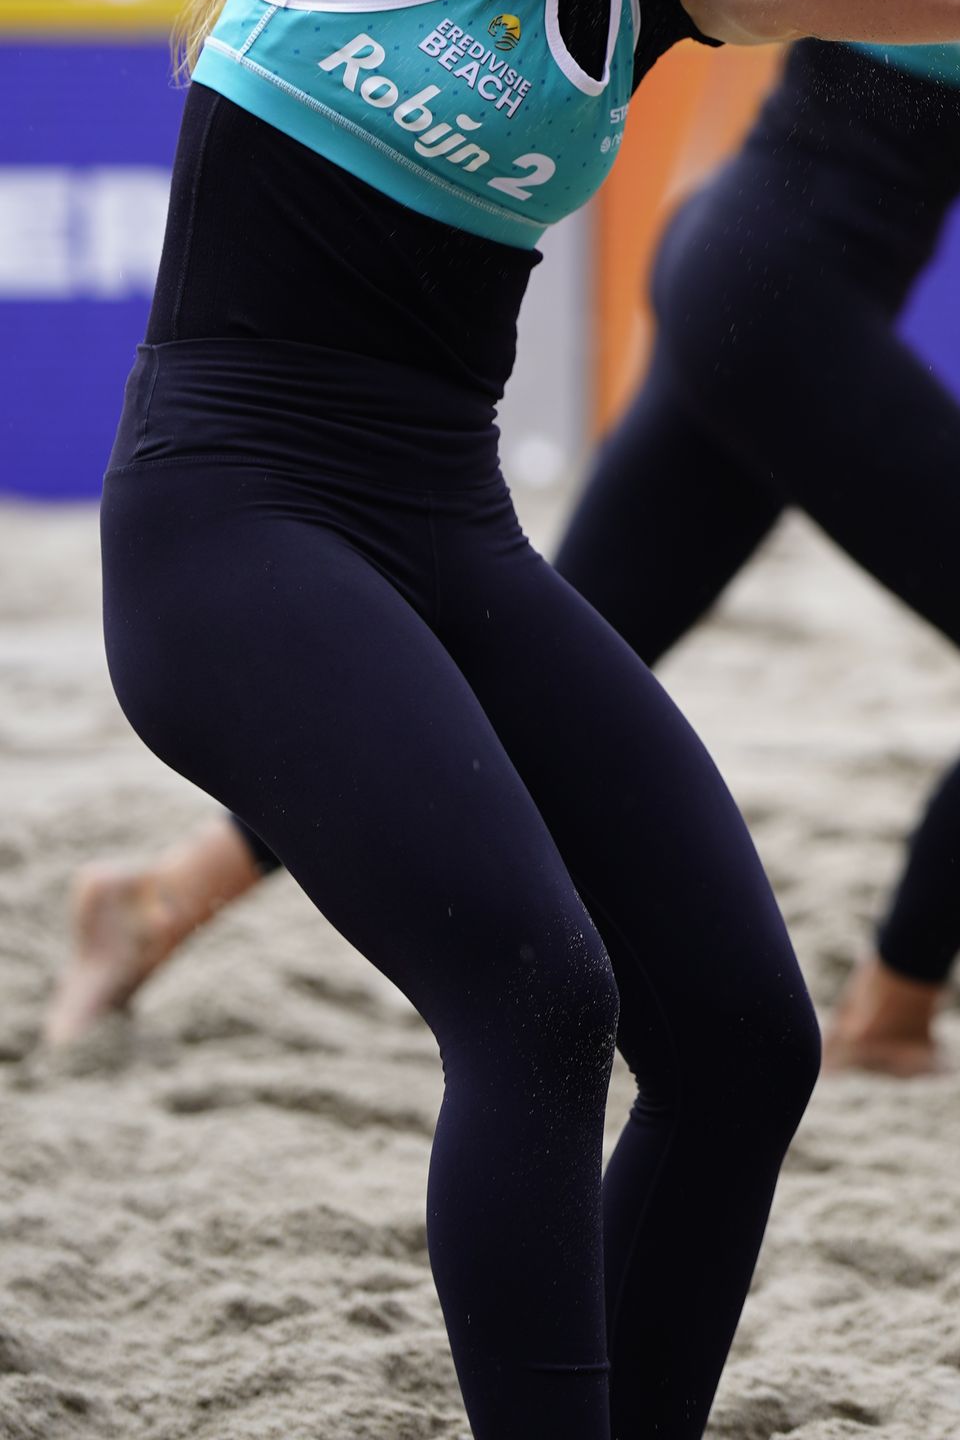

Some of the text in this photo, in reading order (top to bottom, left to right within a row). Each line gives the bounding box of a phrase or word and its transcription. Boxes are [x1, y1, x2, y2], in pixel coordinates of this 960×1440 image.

[418, 30, 524, 119] BEACH
[436, 18, 532, 97] EREDIVISIE
[318, 32, 557, 202] Robijn 2
